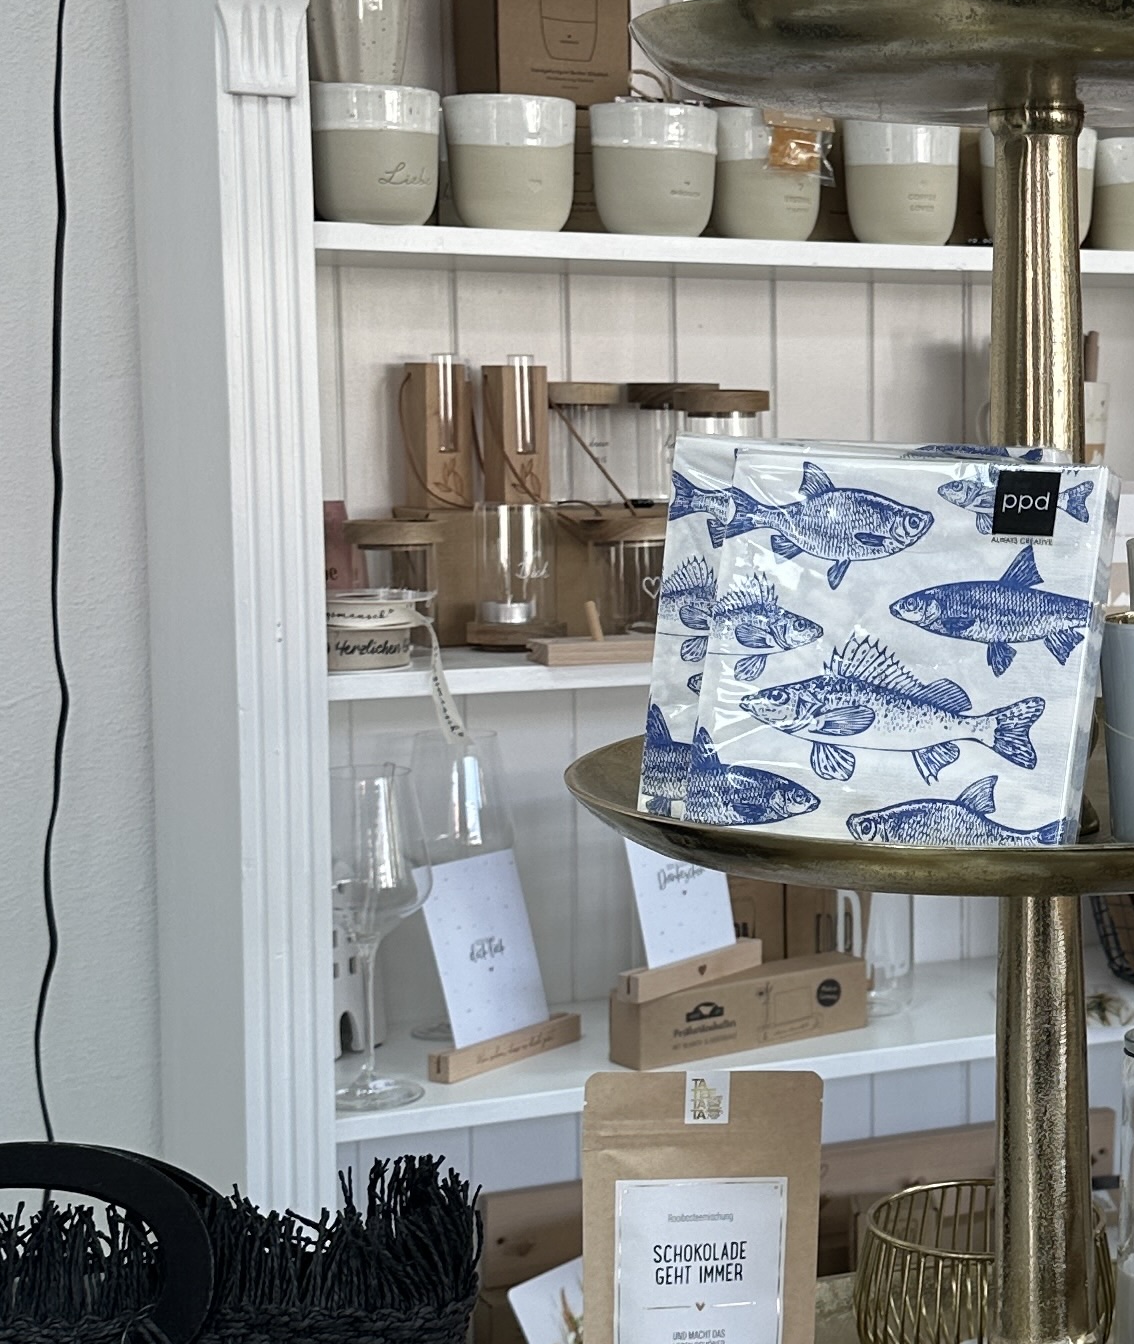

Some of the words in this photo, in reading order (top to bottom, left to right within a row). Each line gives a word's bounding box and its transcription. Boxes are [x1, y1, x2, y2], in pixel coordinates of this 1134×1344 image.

[378, 162, 432, 187] Liebe
[1002, 491, 1051, 514] ppd
[991, 536, 1018, 545] ALWAYS
[335, 639, 401, 656] Herzlichen
[653, 1241, 748, 1263] SCHOKOLADE
[655, 1265, 692, 1285] GEHT
[699, 1262, 743, 1283] IMMER
[672, 1331, 687, 1341] UND
[688, 1329, 712, 1340] MACHT
[712, 1328, 726, 1338] DAS
